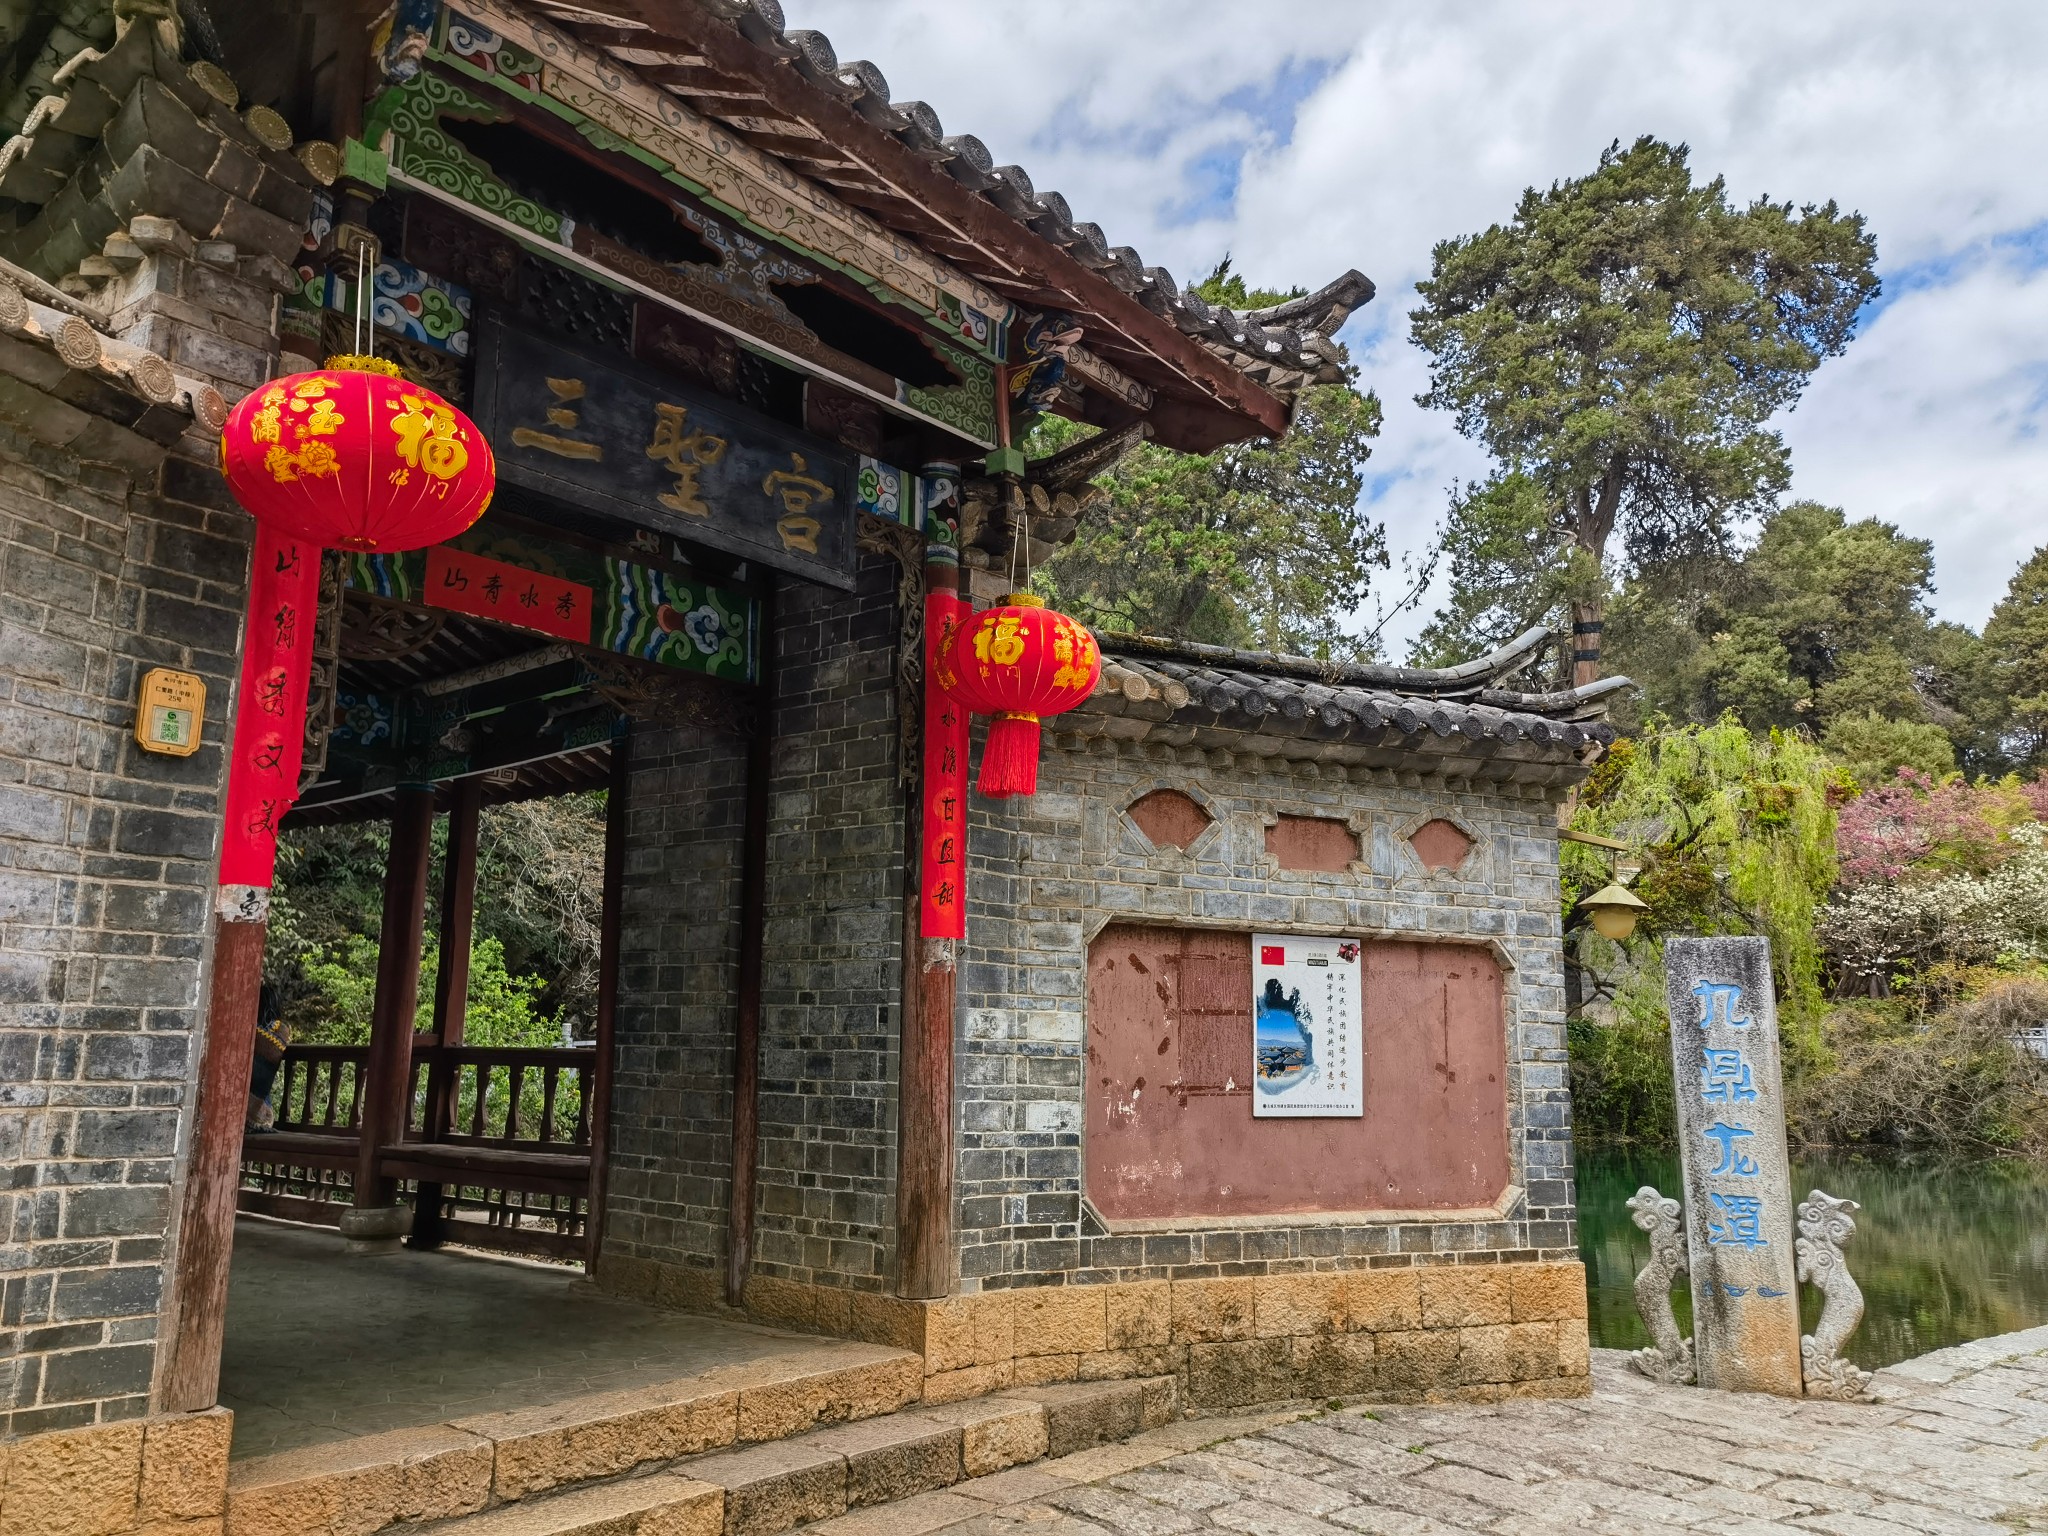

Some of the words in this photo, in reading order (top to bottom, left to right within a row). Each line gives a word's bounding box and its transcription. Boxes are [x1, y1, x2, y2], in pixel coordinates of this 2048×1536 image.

[390, 394, 469, 480] 福
[443, 567, 577, 620] 山青水秀
[973, 617, 1025, 665] 福
[1693, 979, 1770, 1252] 九鼎龙潭
